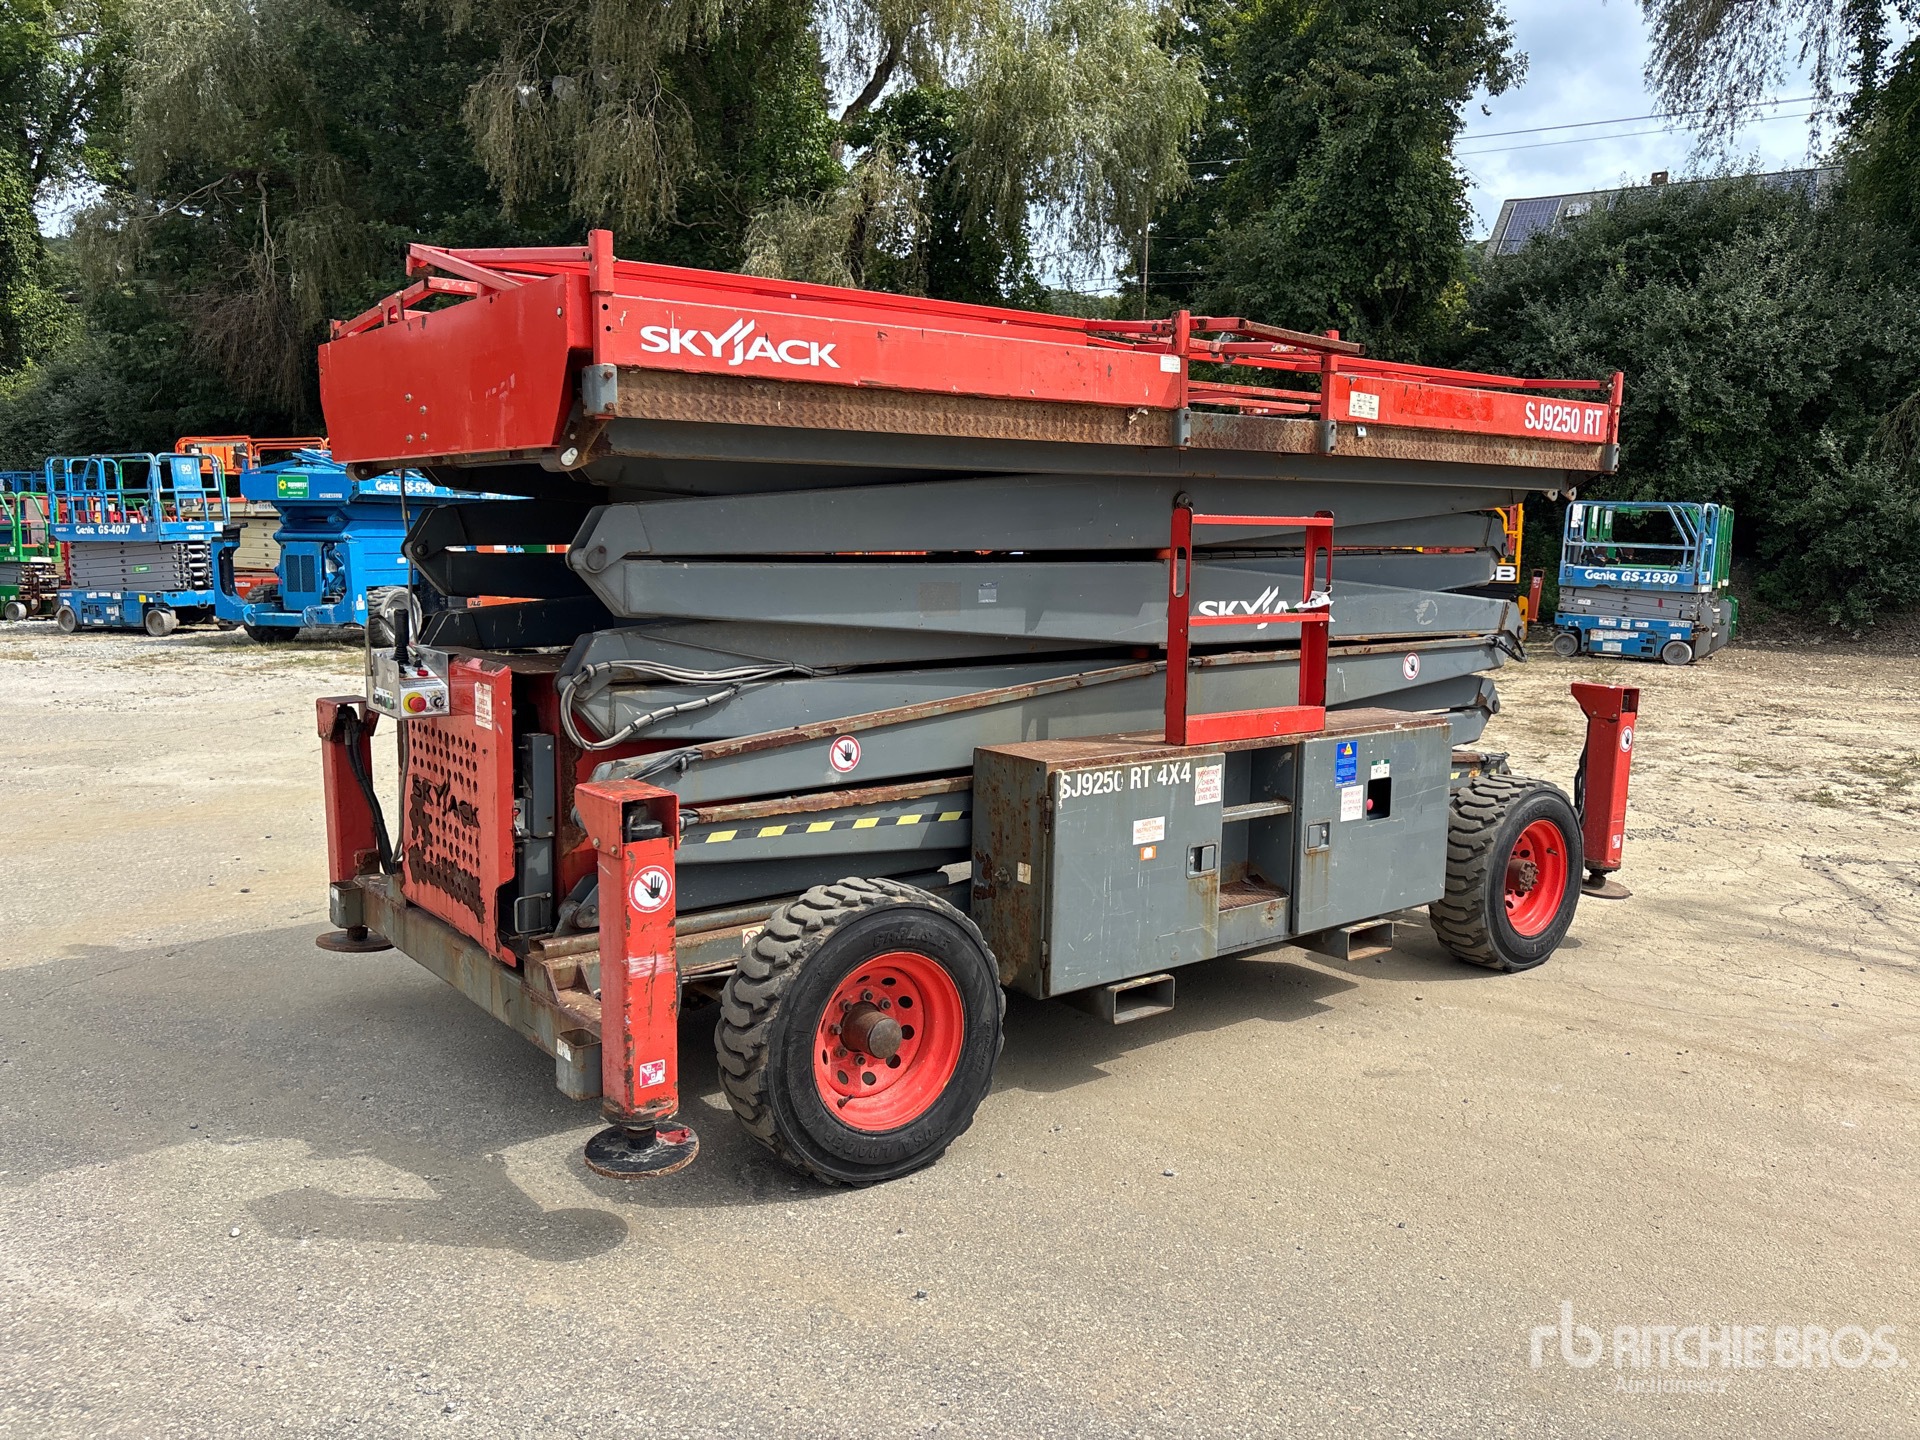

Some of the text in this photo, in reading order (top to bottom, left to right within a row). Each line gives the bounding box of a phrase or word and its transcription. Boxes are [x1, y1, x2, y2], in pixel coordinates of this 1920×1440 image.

[639, 317, 841, 369] SKYJACK
[1524, 401, 1603, 436] SJ9250 RT
[375, 479, 399, 492] Genie
[75, 525, 95, 535] Genie
[98, 525, 131, 535] GS-4047
[1584, 570, 1678, 584] Genie GS-1930
[1060, 761, 1192, 799] SJ9250 RT 4X4
